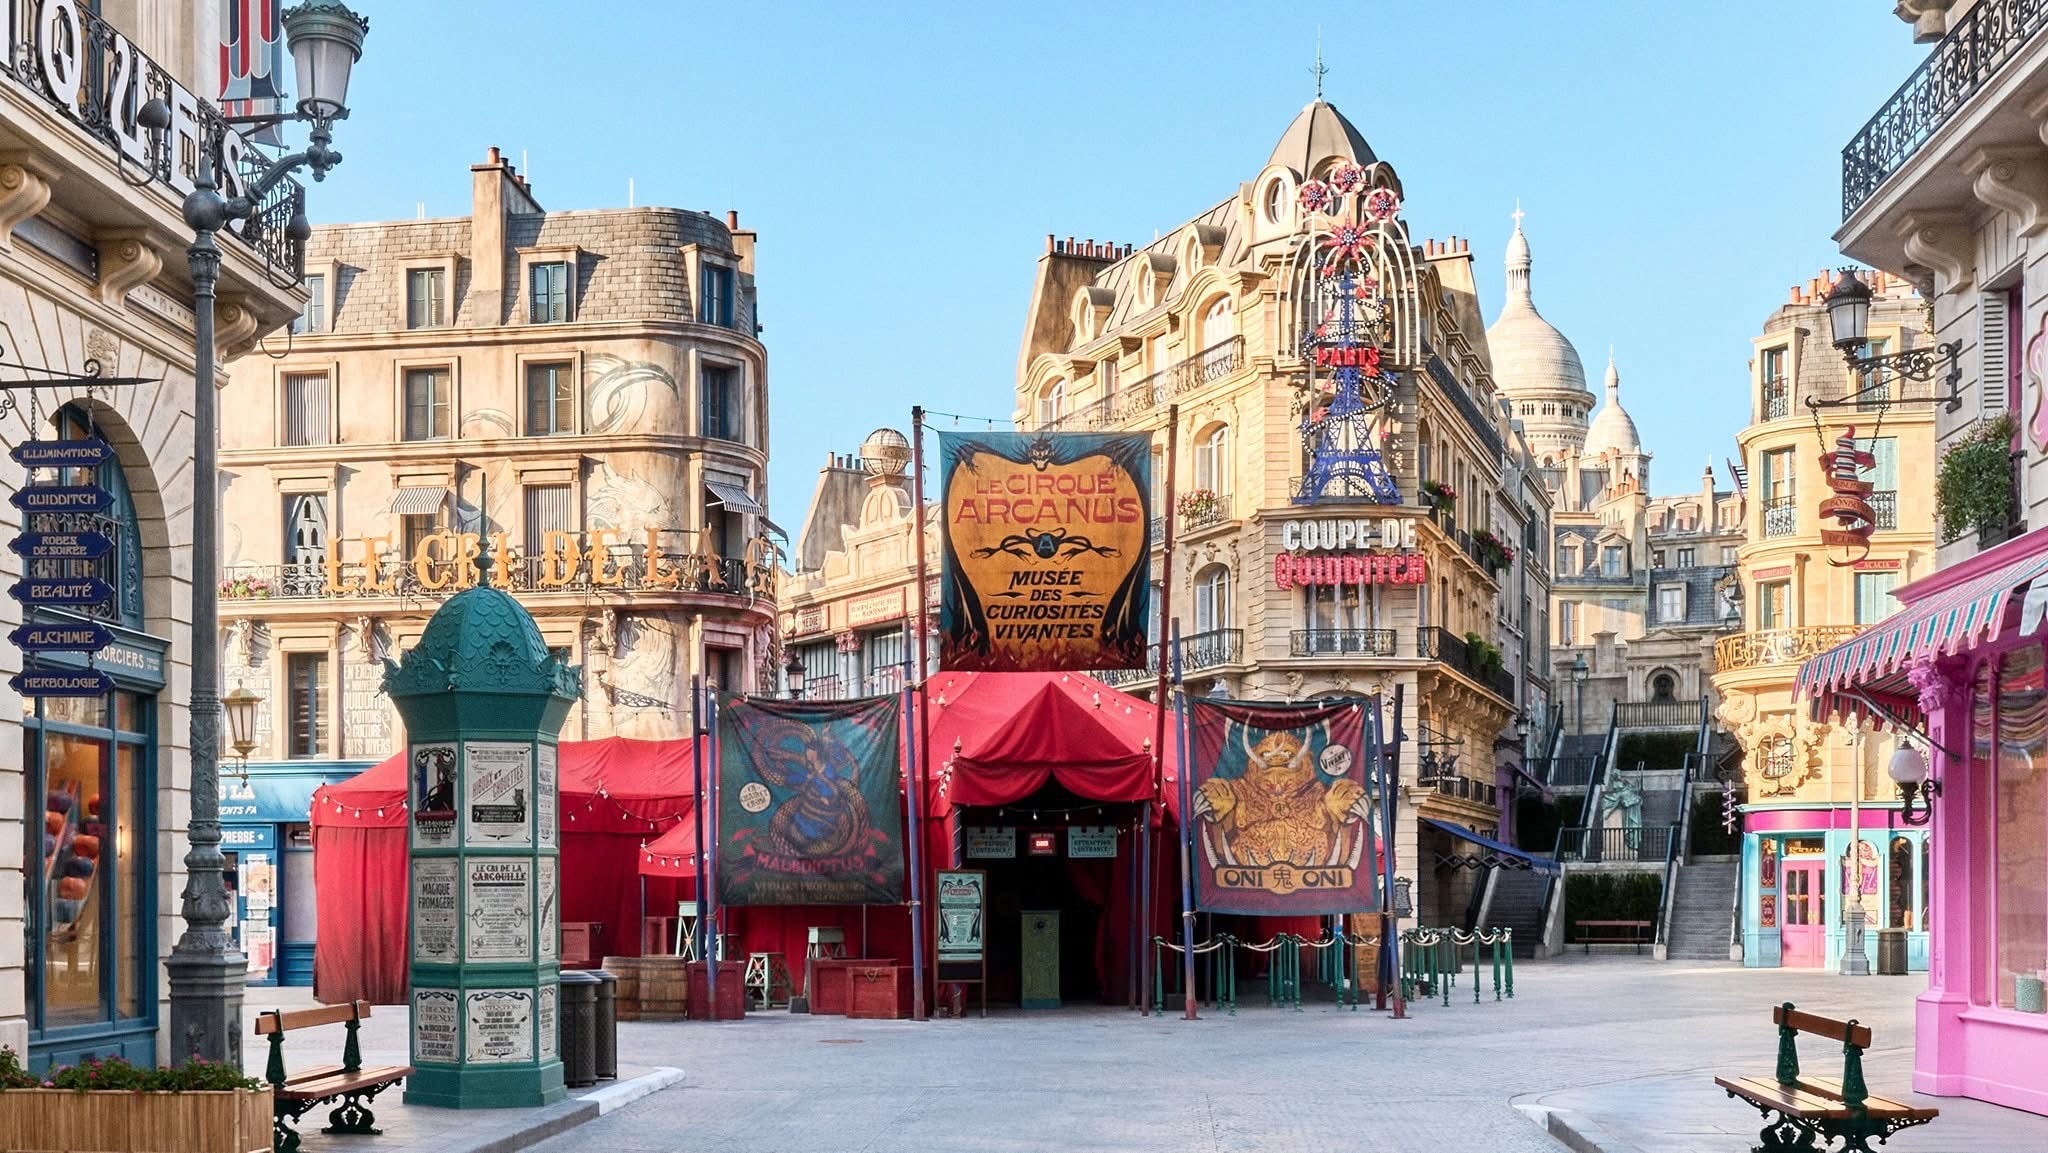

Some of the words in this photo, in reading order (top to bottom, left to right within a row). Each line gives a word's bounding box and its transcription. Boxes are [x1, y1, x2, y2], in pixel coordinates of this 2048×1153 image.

[1317, 347, 1380, 366] PARIS
[23, 448, 102, 459] ILLUMINATIONS
[976, 480, 1003, 495] LE
[1006, 473, 1116, 496] CIRQUE
[28, 494, 97, 505] QUIDDITCH
[955, 498, 1140, 524] ARCANUS
[41, 536, 78, 545] ROBES
[1282, 518, 1371, 550] COUPE
[1381, 518, 1416, 549] DE
[33, 546, 47, 555] DE
[322, 531, 394, 597] LE
[412, 527, 514, 592] CRI
[537, 524, 627, 590] DE
[640, 522, 729, 591] LA
[1008, 567, 1083, 589] MUSÉE
[1274, 552, 1426, 592] QUIDDITCH
[31, 582, 92, 598] BEAUTÉ
[1030, 590, 1062, 601] DES
[986, 602, 1105, 620] CURIOSITÉS
[27, 631, 95, 644] ALCHIMIE
[994, 623, 1095, 643] VIVANTES
[96, 645, 145, 670] SORCIERS
[24, 678, 100, 689] HERBOLOGIE
[351, 710, 382, 724] POTIONS
[352, 724, 382, 738] CULTURE
[365, 738, 391, 755] DIVERS
[229, 784, 256, 800] LA
[472, 872, 526, 881] GARGOUILLE
[476, 864, 486, 873] LE
[486, 864, 498, 872] CRI
[500, 864, 509, 872] DE
[512, 864, 522, 872] LA
[1223, 869, 1263, 887] ONI
[1273, 866, 1294, 889] 鬼
[1302, 869, 1344, 886] ONI
[422, 883, 451, 896] MAGIQUE
